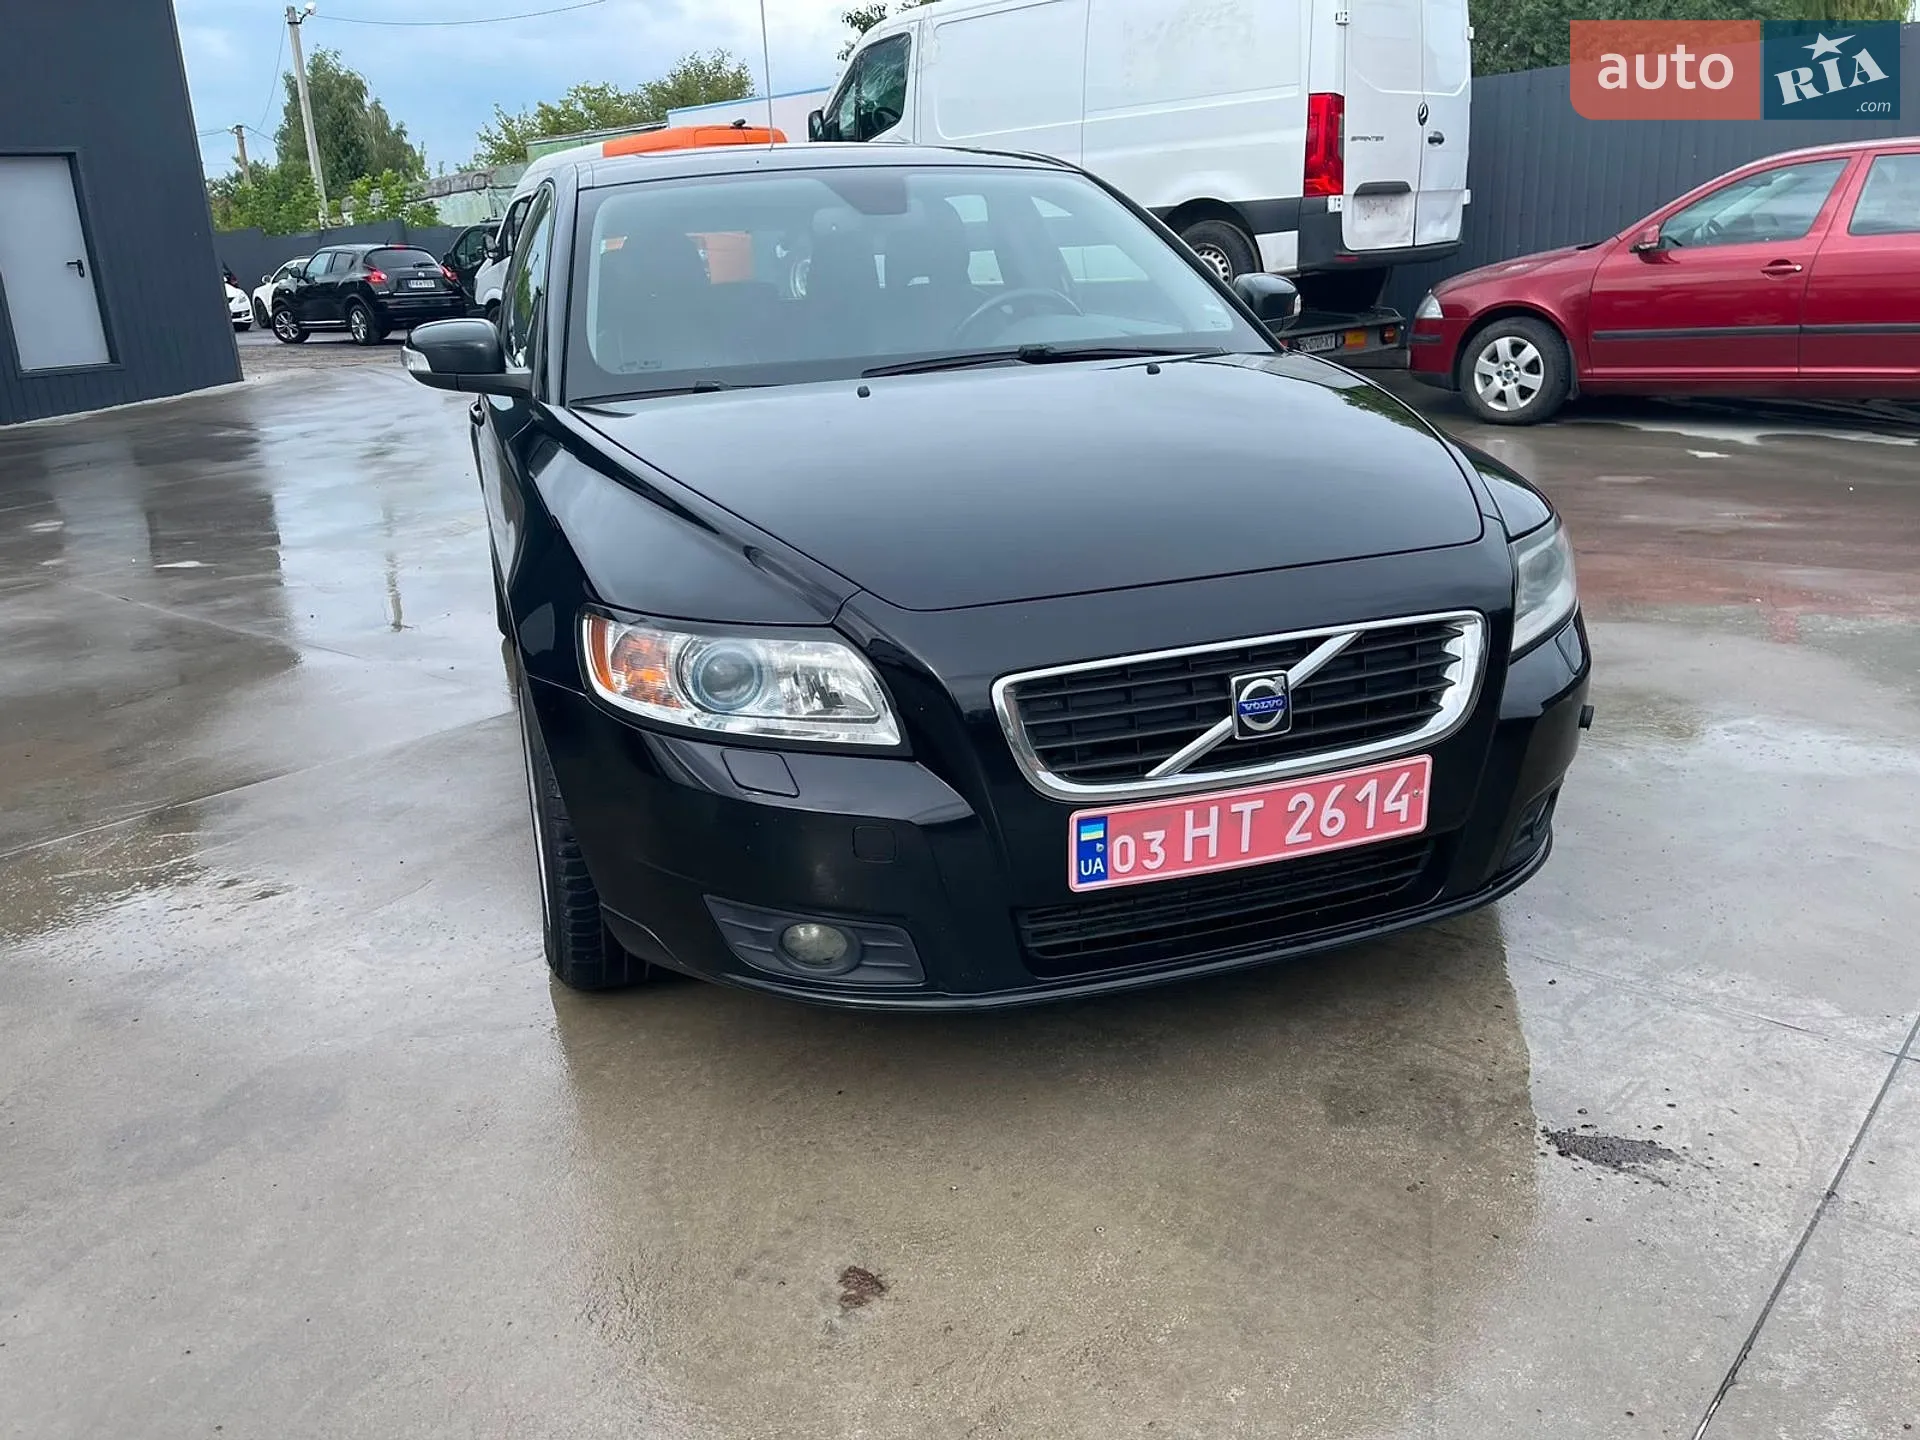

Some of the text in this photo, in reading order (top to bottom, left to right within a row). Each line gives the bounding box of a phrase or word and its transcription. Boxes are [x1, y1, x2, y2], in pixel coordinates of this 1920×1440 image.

[1241, 699, 1283, 711] VOLVO
[1112, 771, 1411, 874] 03 HT 2614
[1080, 857, 1105, 877] UA
